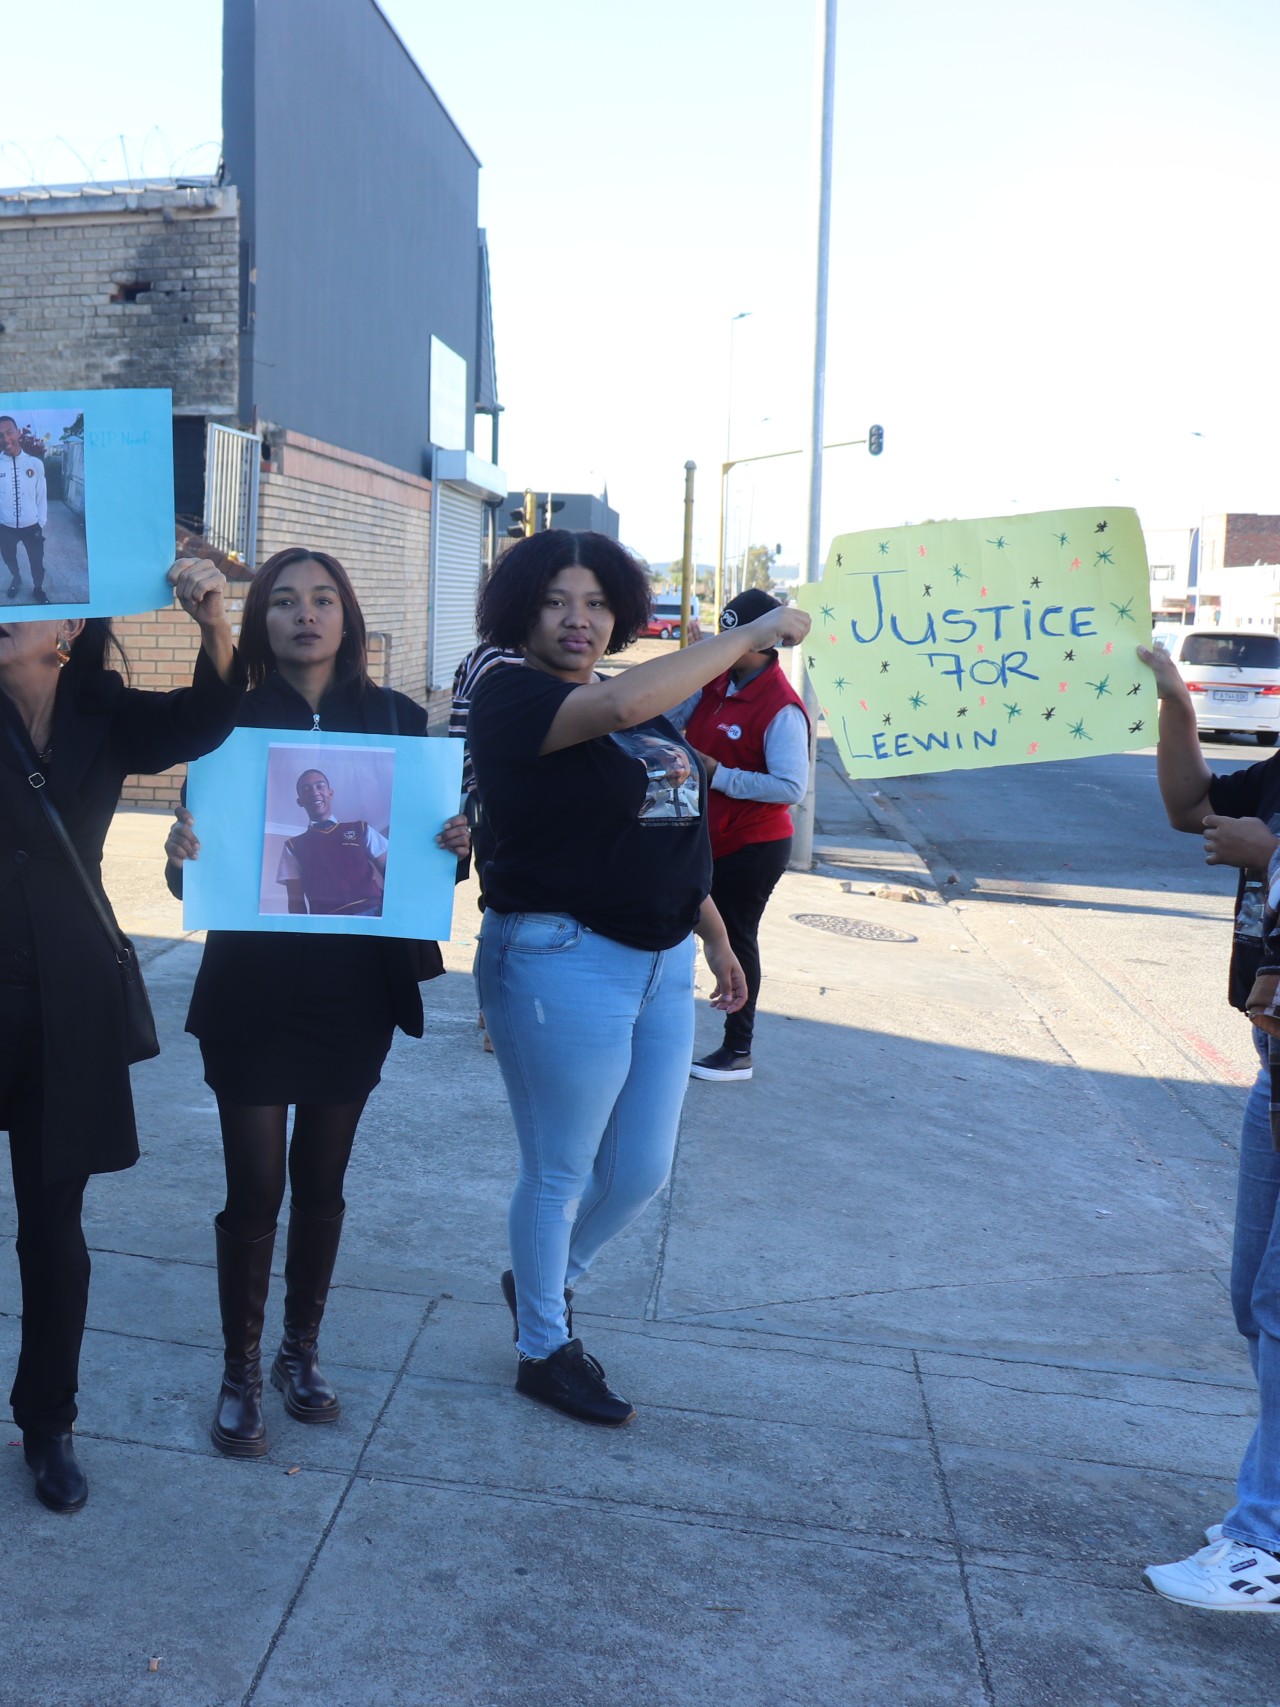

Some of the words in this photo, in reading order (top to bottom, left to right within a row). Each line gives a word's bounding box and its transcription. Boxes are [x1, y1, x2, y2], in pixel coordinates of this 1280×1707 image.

[89, 430, 117, 448] RIP
[845, 569, 1098, 645] JUSTICE
[841, 716, 998, 760] LEEWIN
